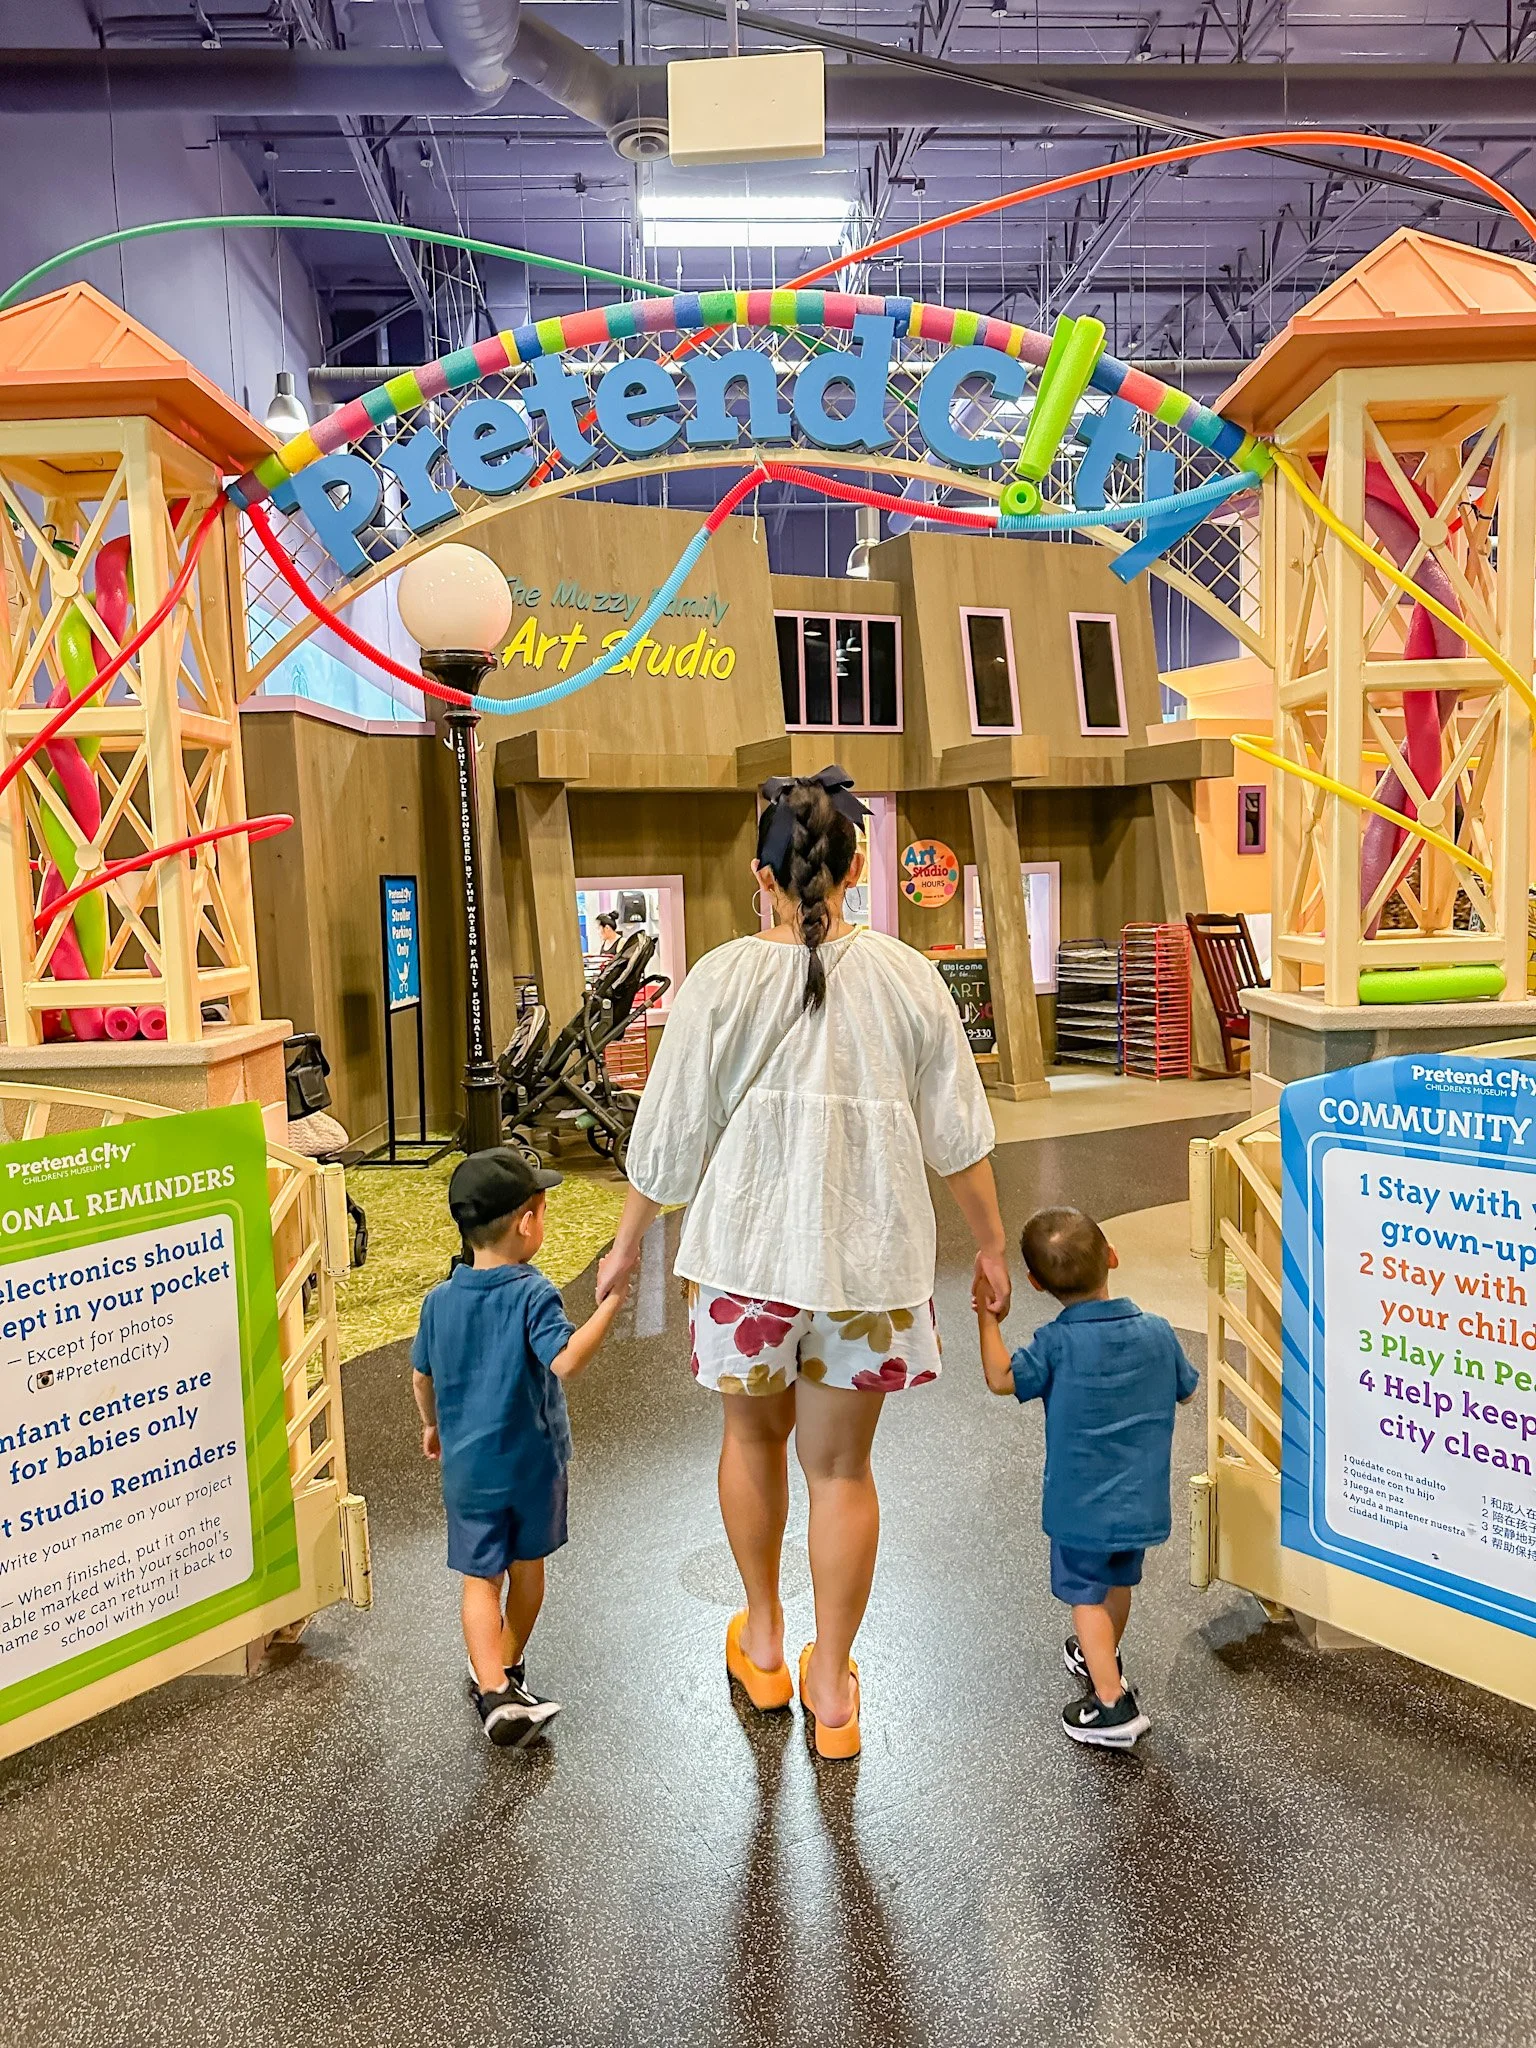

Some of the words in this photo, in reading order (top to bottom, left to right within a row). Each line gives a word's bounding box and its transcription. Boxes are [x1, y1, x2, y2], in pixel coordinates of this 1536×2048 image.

[269, 315, 896, 577] Pretend
[550, 579, 641, 622] Muzzy
[650, 587, 729, 628] amily
[501, 616, 587, 672] Art
[593, 628, 736, 680] Studio
[457, 732, 465, 766] LIGHT
[462, 802, 471, 861] SPONSORED
[466, 866, 472, 878] BY
[905, 846, 936, 866] Art
[913, 865, 948, 877] Studio
[392, 908, 411, 922] Stroller
[466, 883, 474, 902] THE
[392, 925, 412, 940] Parking
[467, 906, 477, 945] WATSON
[396, 942, 409, 958] Only
[470, 950, 479, 988] FAMILY
[950, 982, 985, 997] ART
[472, 993, 482, 1056] FOUNDATION
[1411, 1065, 1494, 1086] Pretend
[1426, 1084, 1471, 1094] CHILDREN'S
[1473, 1088, 1507, 1097] MUSEUM
[1319, 1098, 1532, 1145] COMMUNITY
[6, 1148, 89, 1178] Pretend
[23, 1169, 69, 1185] CHILDREN'S
[70, 1164, 102, 1176] MUSEUM
[0, 1199, 79, 1236] ONAL
[86, 1166, 235, 1217] REMINDERS
[1360, 1173, 1370, 1196] 1
[1378, 1176, 1440, 1214] Stay
[1449, 1188, 1522, 1220] with
[144, 1229, 224, 1266] should
[0, 1310, 47, 1341] ept
[55, 1303, 81, 1325] in
[87, 1286, 143, 1321] your
[151, 1262, 230, 1303] pocket
[1359, 1252, 1374, 1276] 2
[1382, 1256, 1446, 1296] Stay
[1454, 1272, 1528, 1307] with
[28, 1336, 84, 1365] Except
[91, 1331, 114, 1351] for
[120, 1313, 174, 1342] photos
[1380, 1300, 1449, 1330] your
[1458, 1312, 1536, 1350] child
[1359, 1330, 1372, 1352] 3
[1382, 1334, 1444, 1376] Play
[1454, 1349, 1485, 1381] in
[1494, 1361, 1536, 1392] Pe
[79, 1383, 169, 1427] centers
[176, 1371, 212, 1396] are
[1359, 1369, 1376, 1392] 4
[1384, 1374, 1453, 1417] Help
[1462, 1391, 1536, 1441] keep
[10, 1457, 48, 1485] for
[56, 1425, 140, 1469] babies
[148, 1404, 198, 1436] only
[1380, 1415, 1435, 1453] city
[1445, 1432, 1532, 1476] clean
[20, 1488, 104, 1532] Studio
[111, 1440, 237, 1499] Reminders
[1349, 1455, 1384, 1473] Quédate
[1387, 1469, 1402, 1478] con
[1404, 1472, 1414, 1482] tu
[1416, 1476, 1446, 1492] adulto
[1349, 1480, 1374, 1495] Juega
[1376, 1488, 1386, 1498] en
[1389, 1493, 1404, 1504] paz
[1350, 1468, 1386, 1485] Quédate
[1388, 1482, 1403, 1491] con
[1406, 1485, 1415, 1494] tu
[1417, 1488, 1435, 1502] hijo
[0, 1552, 37, 1575] Write
[42, 1537, 77, 1562] your
[82, 1520, 122, 1543] name
[128, 1511, 145, 1524] on
[149, 1497, 181, 1520] your
[186, 1475, 232, 1506] project
[1349, 1492, 1376, 1508] Ayuda
[1385, 1505, 1428, 1525] mantener
[1431, 1518, 1466, 1537] nuestra
[1349, 1505, 1378, 1523] ciudad
[1380, 1513, 1408, 1532] limpia
[1482, 1508, 1488, 1518] 2
[1482, 1522, 1488, 1531] 3
[18, 1580, 62, 1605] When
[67, 1556, 131, 1590] finished,
[136, 1538, 160, 1562] put
[164, 1533, 173, 1550] it
[179, 1528, 196, 1542] on
[199, 1516, 220, 1535] the
[1481, 1536, 1487, 1544] 4
[42, 1581, 99, 1616] marked
[104, 1569, 135, 1590] with
[139, 1556, 172, 1578] your
[175, 1530, 229, 1560] school's
[44, 1621, 60, 1635] so
[65, 1609, 86, 1625] we
[91, 1596, 116, 1615] can
[121, 1579, 166, 1602] return
[170, 1570, 180, 1585] it
[183, 1555, 216, 1578] back
[220, 1547, 232, 1562] to
[61, 1615, 108, 1647] school
[113, 1605, 145, 1626] with
[148, 1585, 180, 1615] you!
